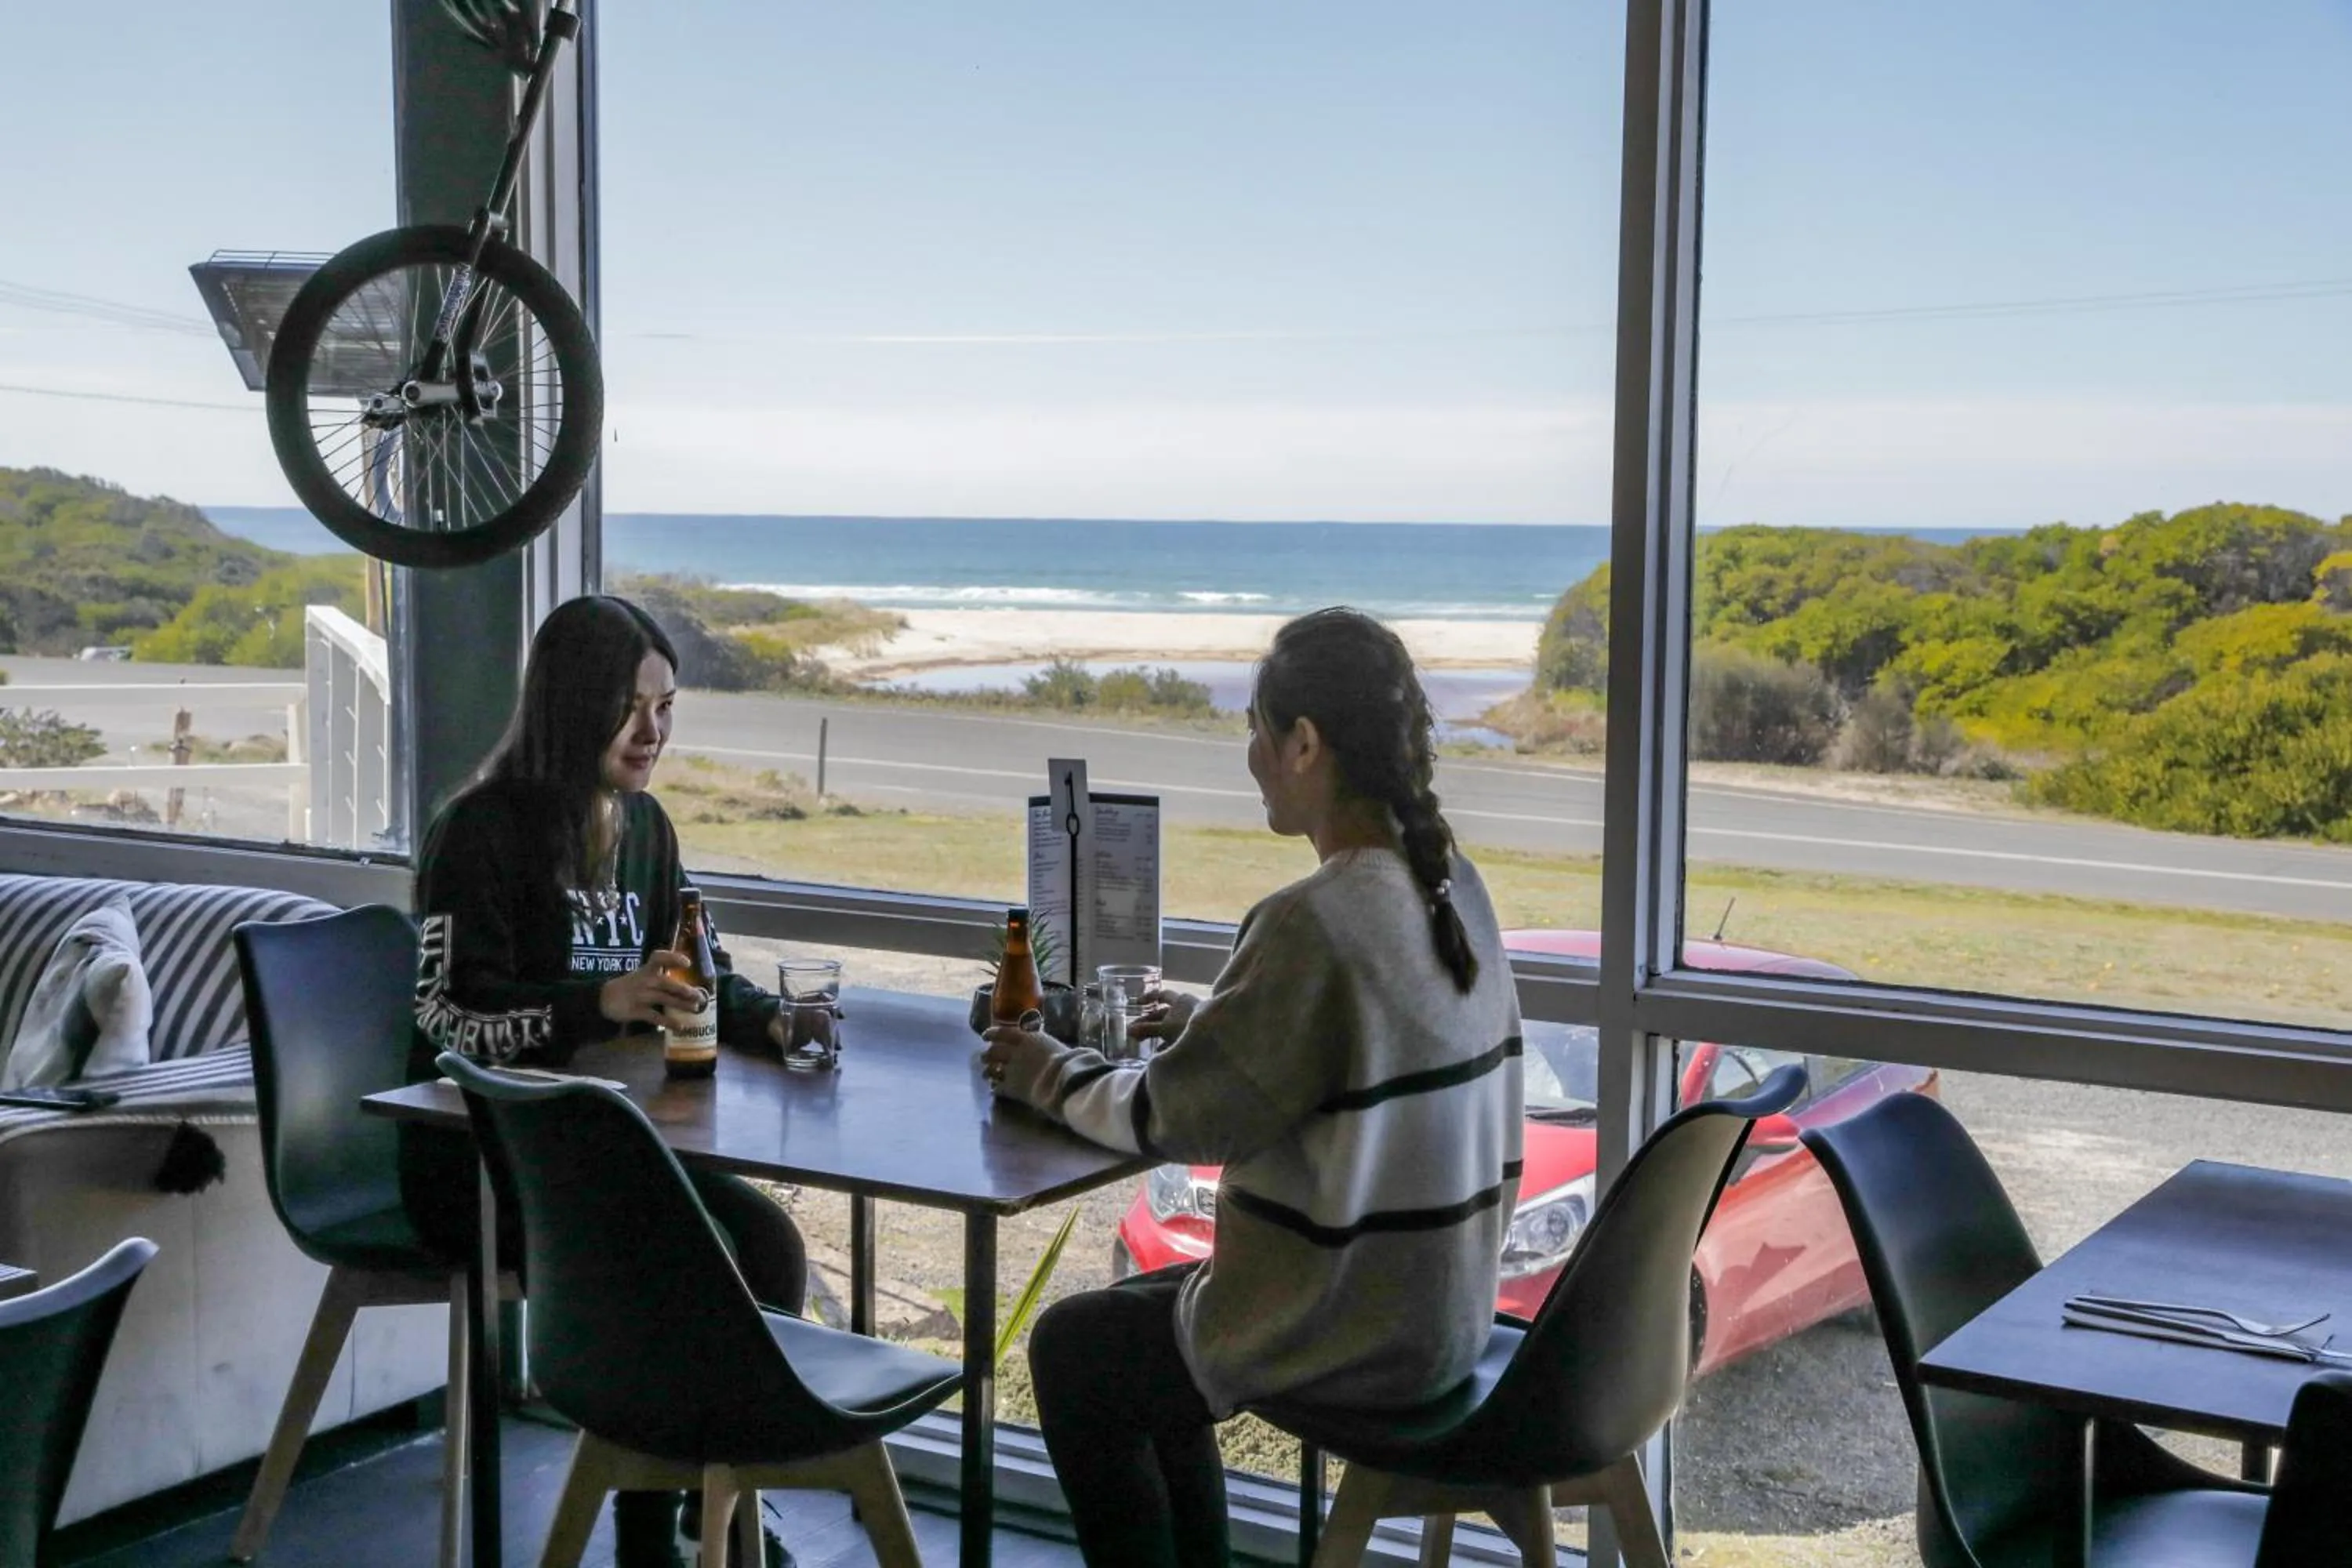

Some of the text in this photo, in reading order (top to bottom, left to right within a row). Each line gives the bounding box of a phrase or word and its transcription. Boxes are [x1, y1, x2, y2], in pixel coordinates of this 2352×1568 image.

[571, 956, 641, 971] NEW YORK CIT
